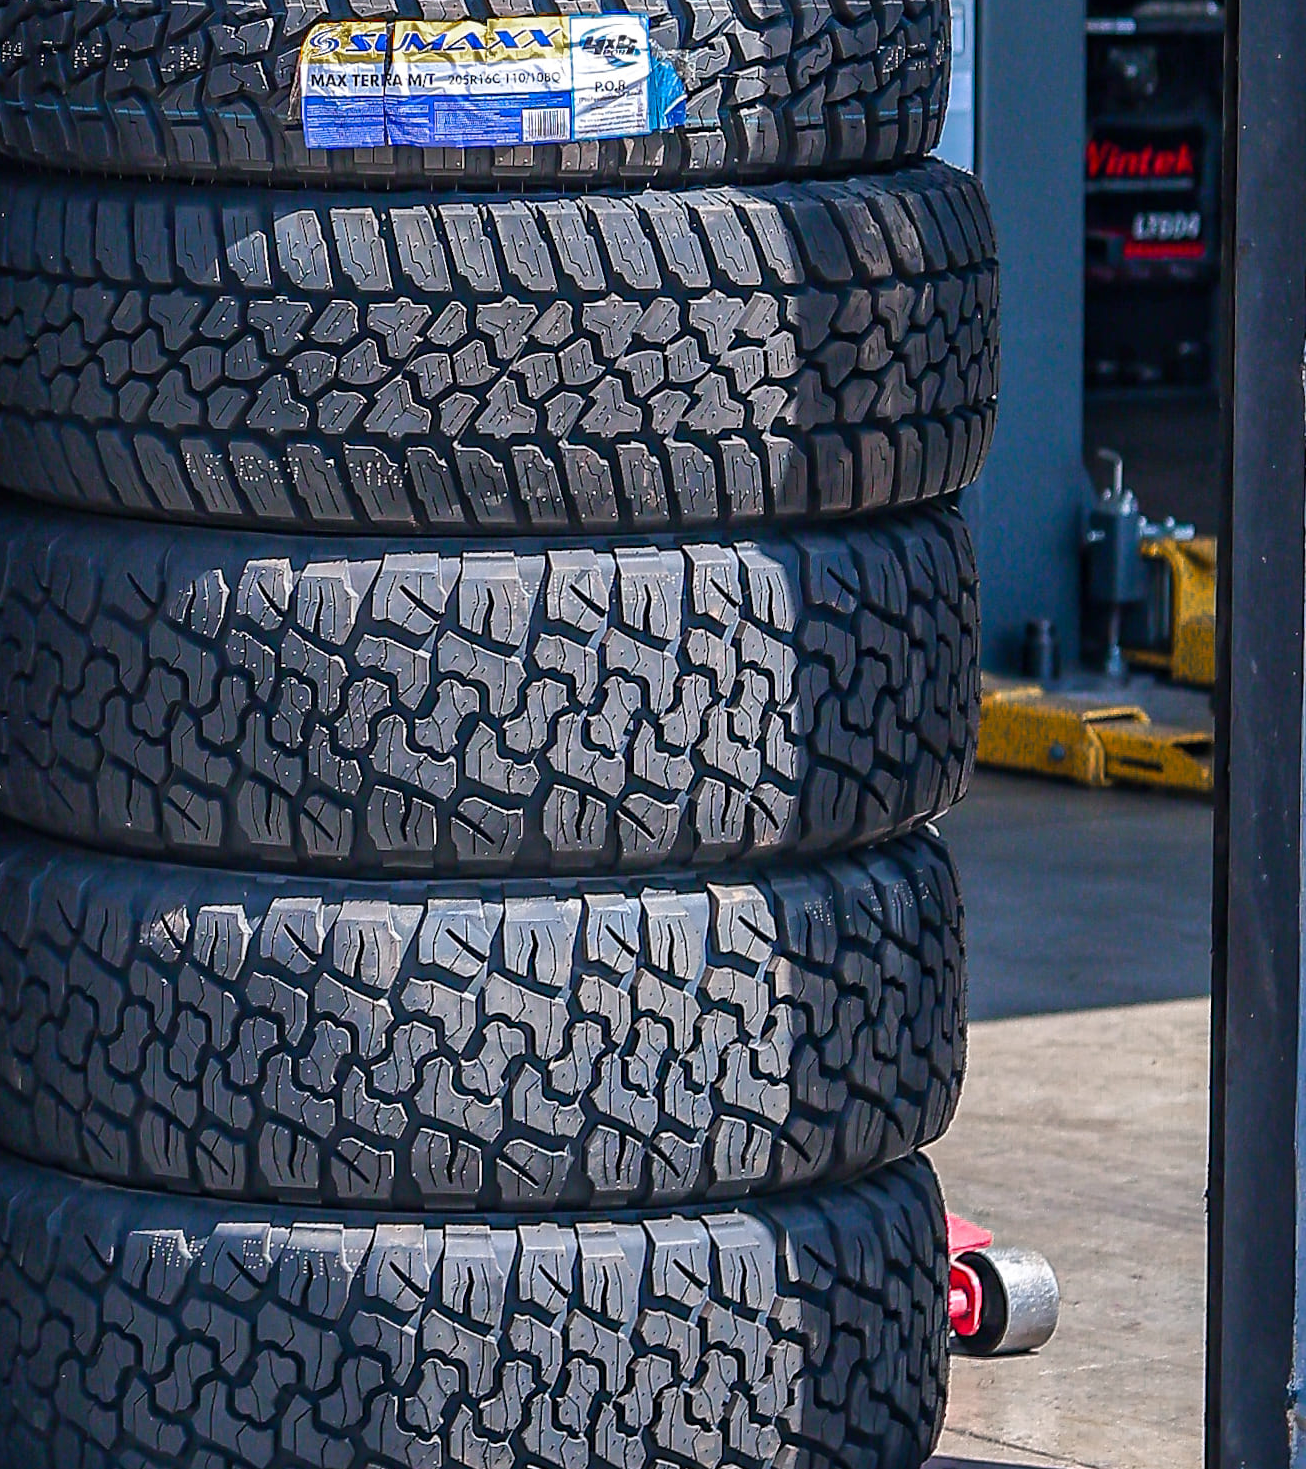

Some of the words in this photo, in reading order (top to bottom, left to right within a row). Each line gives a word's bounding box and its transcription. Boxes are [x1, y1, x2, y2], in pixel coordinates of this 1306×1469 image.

[344, 27, 562, 53] SUMAXX
[311, 73, 347, 88] MAX
[352, 73, 403, 88] TERRA
[407, 73, 435, 87] M/T
[448, 72, 501, 86] 205R16C
